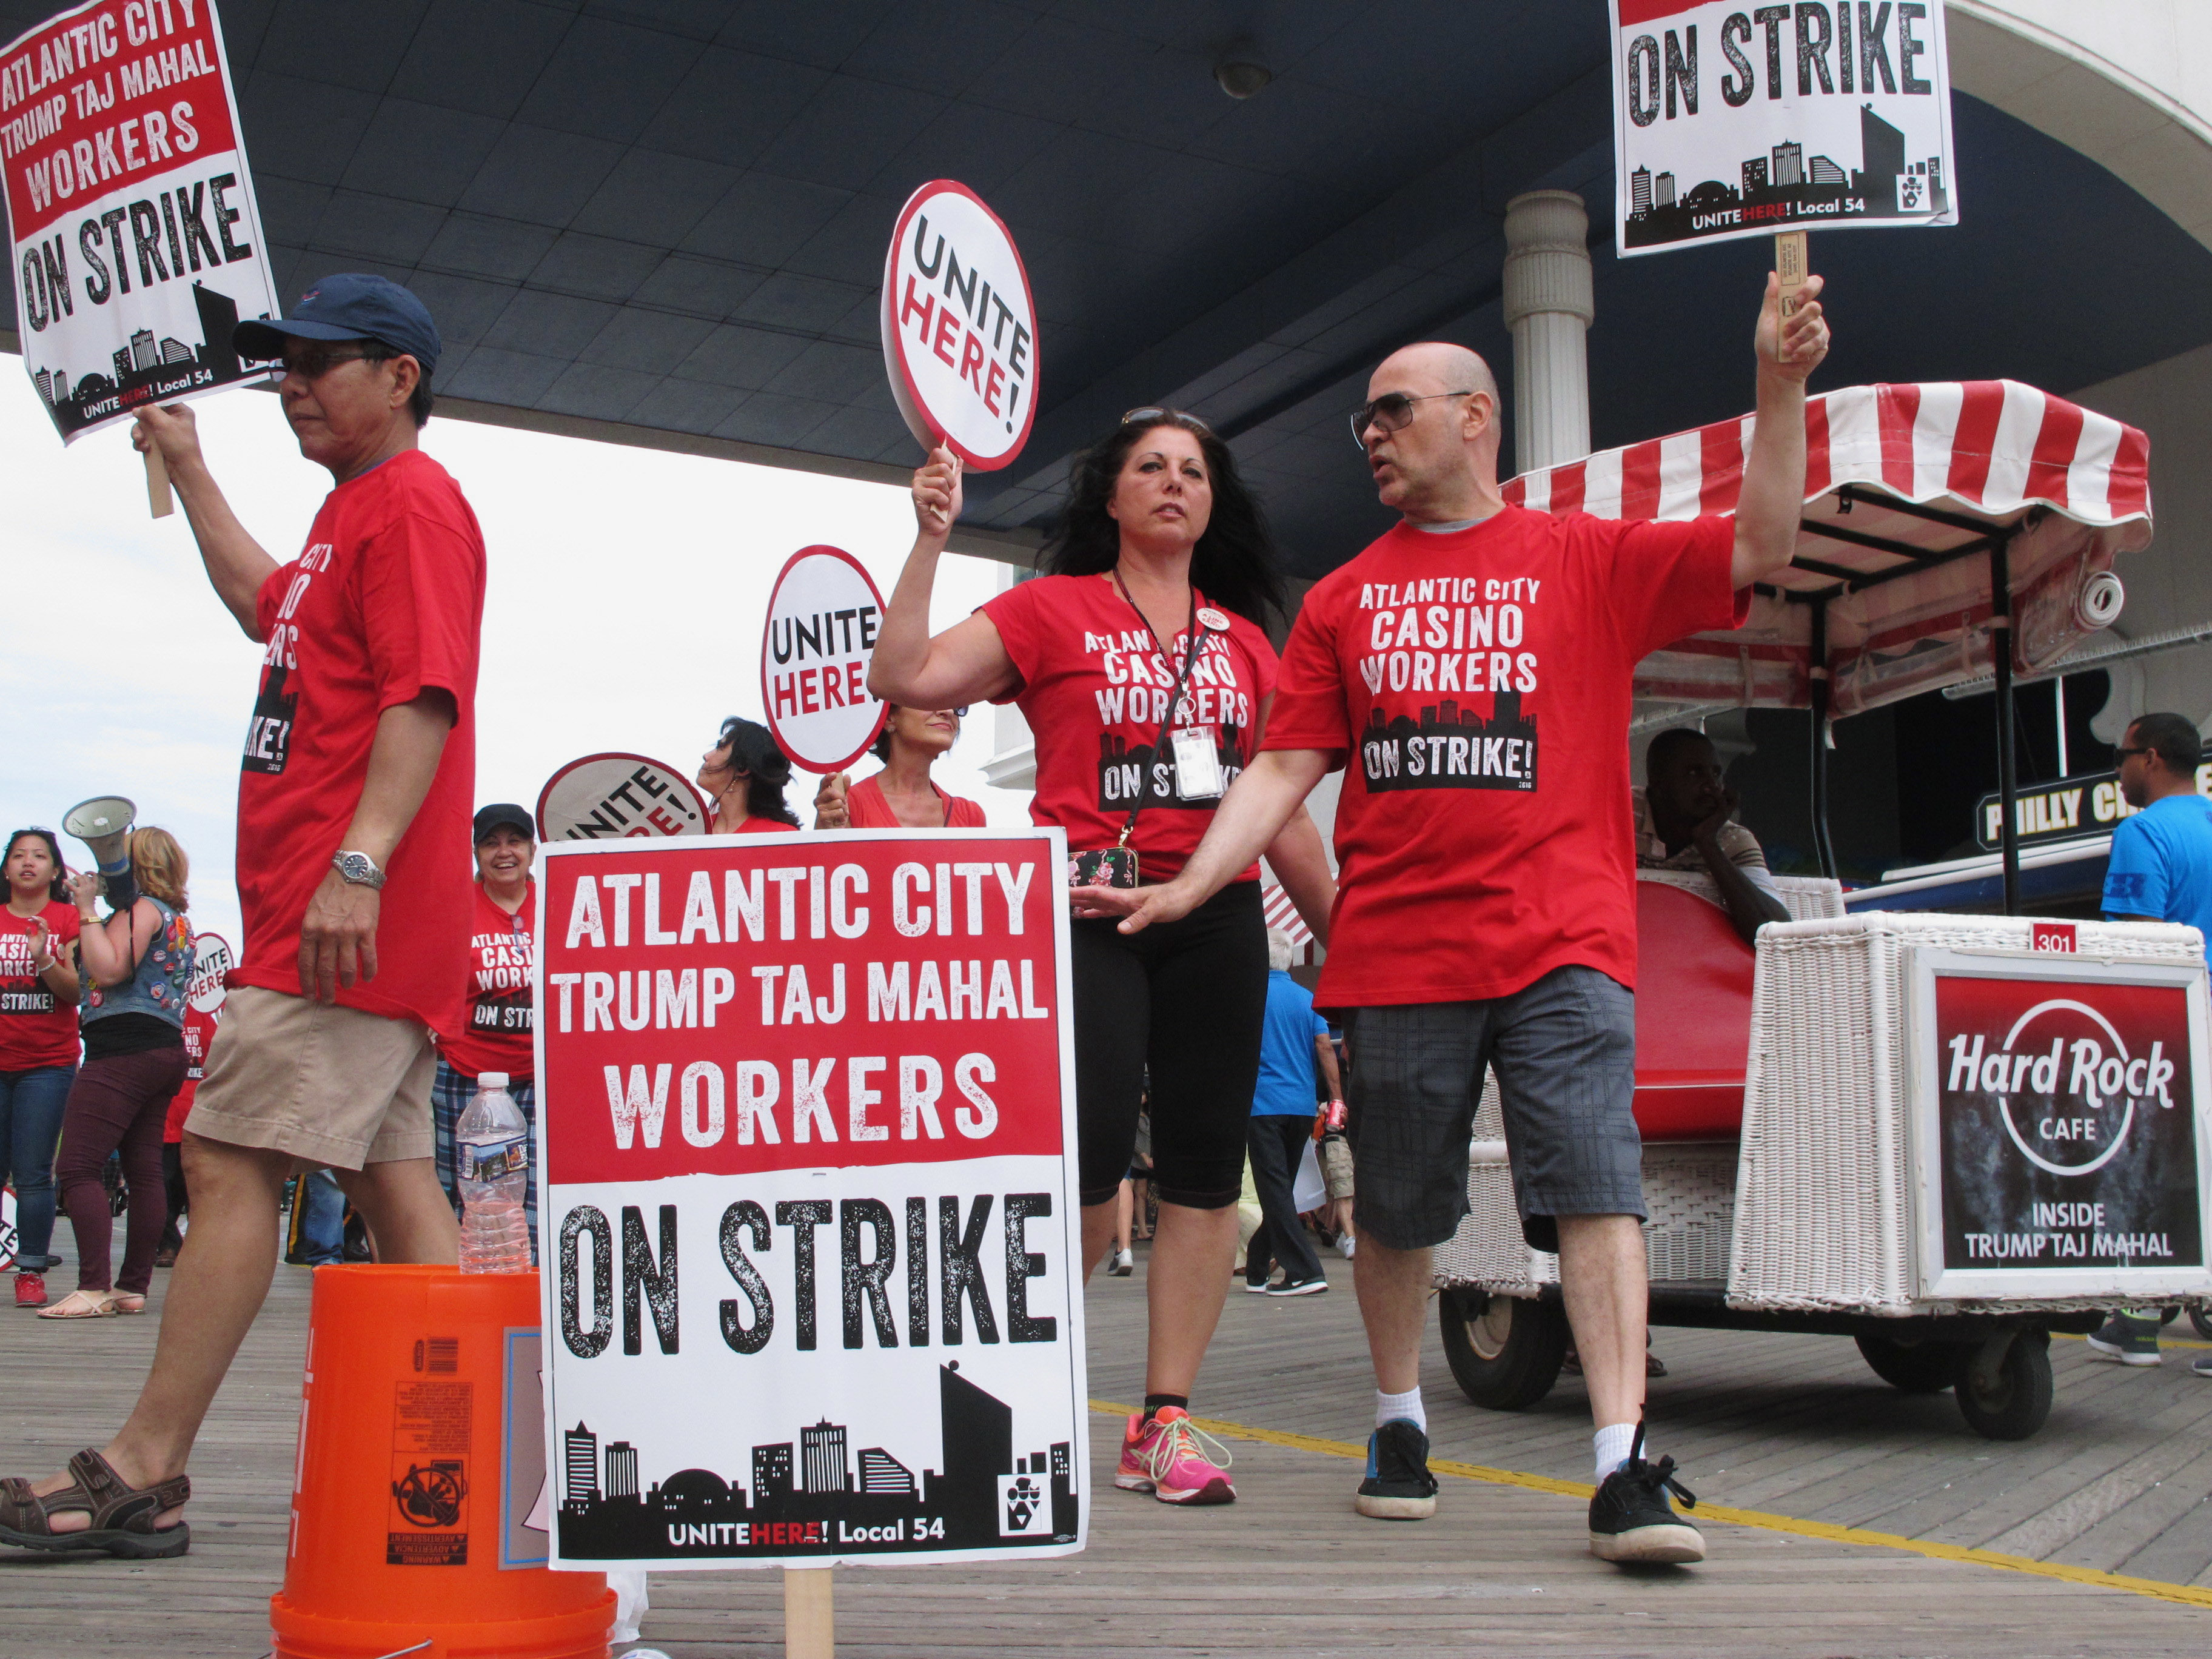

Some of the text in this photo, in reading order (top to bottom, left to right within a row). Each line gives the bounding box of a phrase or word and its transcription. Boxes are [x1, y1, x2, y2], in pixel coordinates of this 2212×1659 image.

[2, 0, 195, 112] ATLANTIC CITY
[1627, 1, 1932, 127] ON STRIKE
[1, 39, 216, 159] TRUMP TAJ MAHAL
[25, 101, 199, 213] WORKERS
[1797, 198, 1840, 216] Local
[1845, 198, 1866, 213] 54
[23, 172, 253, 332] ON STRIKE
[913, 213, 1030, 380] UNITE
[900, 272, 1020, 435] HERE!
[157, 376, 192, 395] Local
[195, 369, 213, 384] 54
[300, 543, 333, 572] CITY
[1359, 577, 1541, 610] ATLANTIC CITY
[772, 605, 877, 665] UNITE
[1370, 604, 1523, 651] CASINO
[774, 659, 879, 720] HERE
[1359, 650, 1538, 697] WORKERS
[1104, 763, 1141, 800] ON
[1364, 736, 1533, 780] ON STRIKE!
[565, 862, 1036, 948] ATLANTIC CITY
[471, 931, 532, 948] ATLANTIC
[2038, 934, 2071, 953] 301
[1, 993, 54, 1010] STRIKE!
[475, 1004, 498, 1026] ON
[550, 959, 1050, 1033] TRUMP TAJ MAHAL
[1947, 1033, 2175, 1109] Hard Rock
[603, 1051, 999, 1150] WORKERS
[2039, 1118, 2096, 1141] CAFE
[2032, 1203, 2105, 1227] INSIDE
[1965, 1233, 2173, 1258] TRUMP TAJ MAHAL
[559, 1192, 1057, 1359] ON STRIKE
[838, 1518, 904, 1543] Local
[912, 1517, 946, 1540] 54
